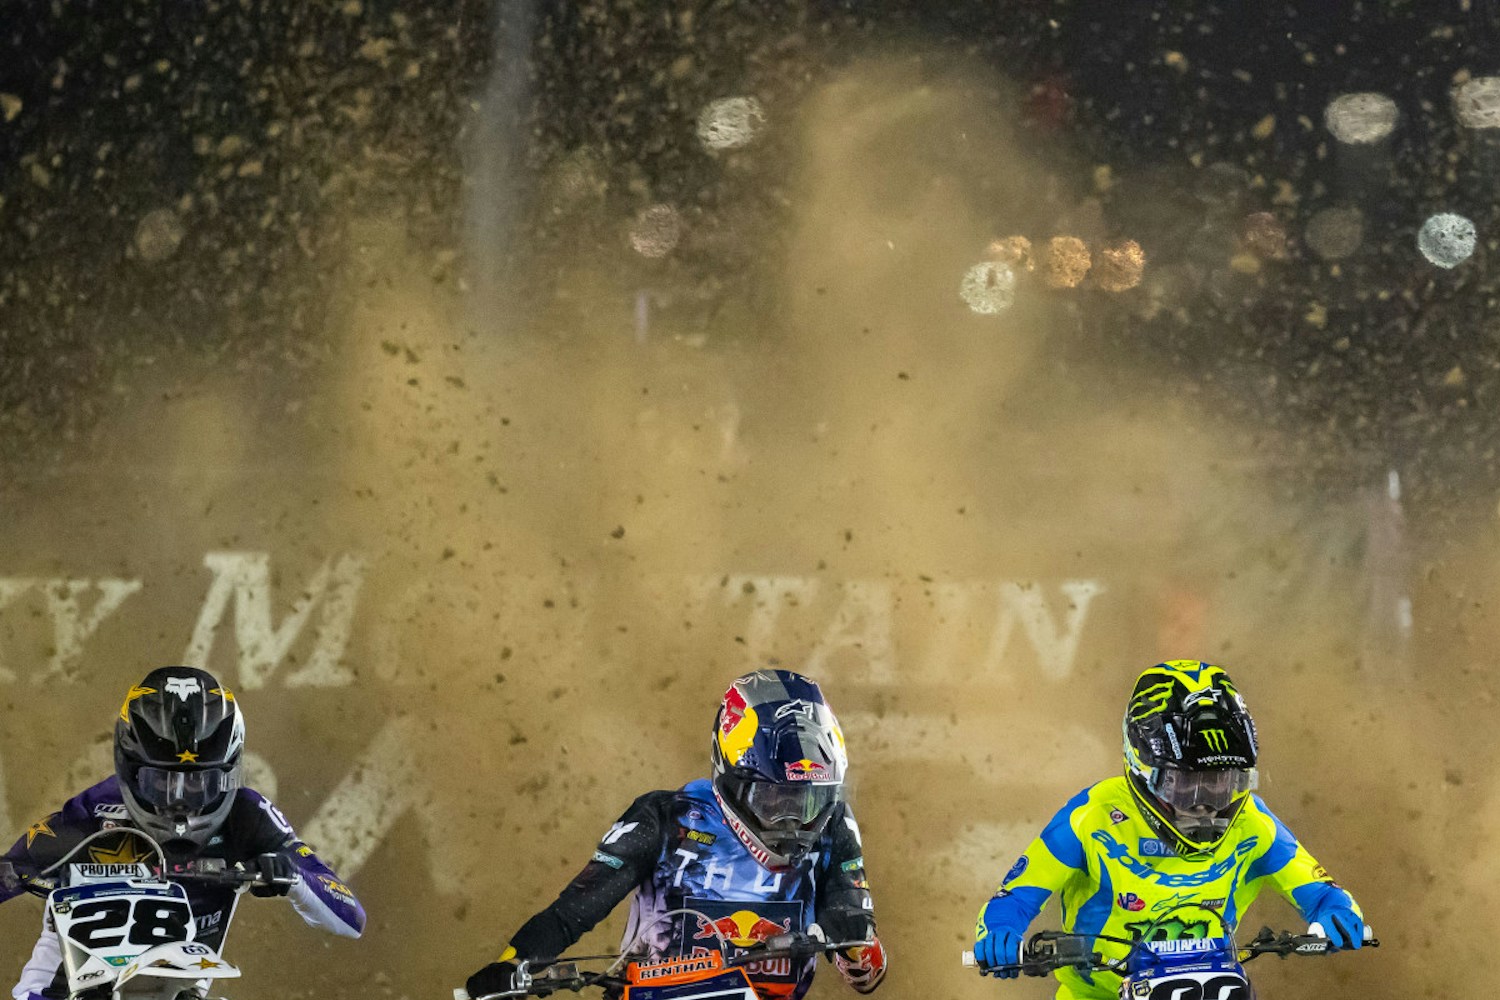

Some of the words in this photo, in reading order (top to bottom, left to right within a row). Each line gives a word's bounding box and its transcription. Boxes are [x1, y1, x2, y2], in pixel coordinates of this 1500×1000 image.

[80, 864, 138, 877] PROTAPER
[68, 899, 189, 949] 28
[640, 961, 719, 980] RENTHAL
